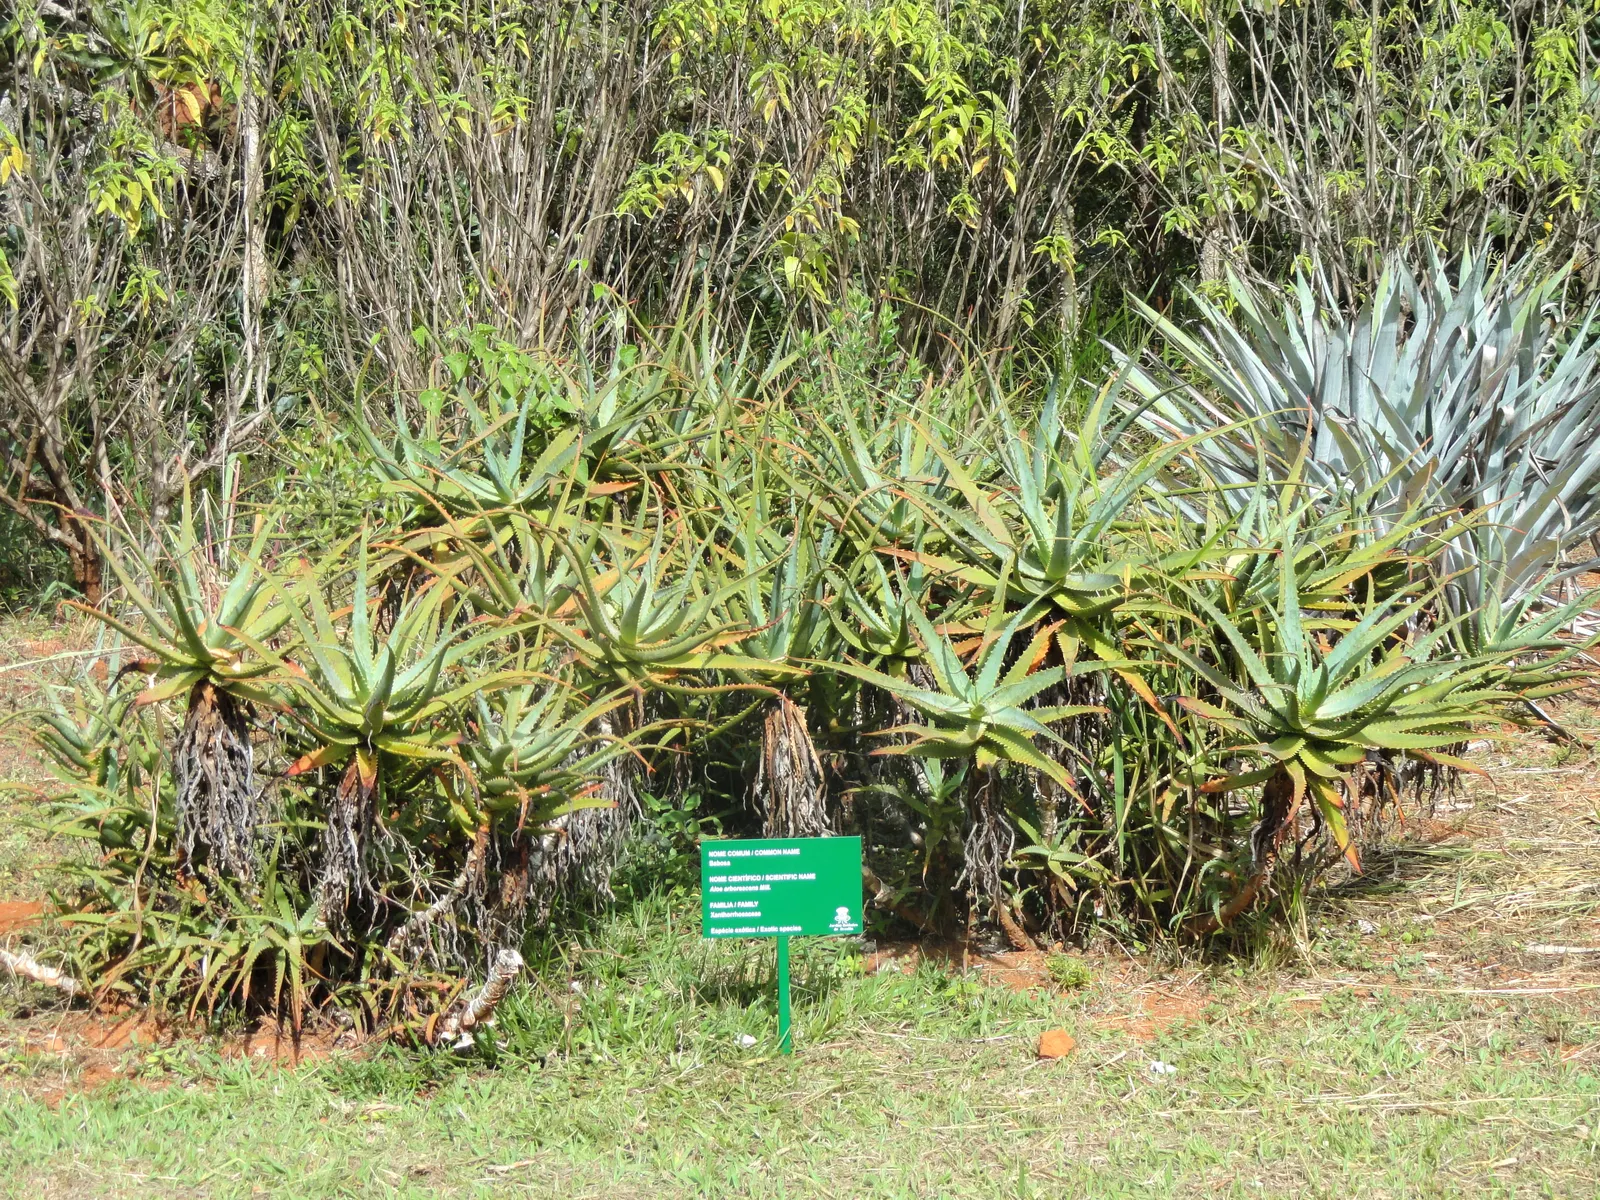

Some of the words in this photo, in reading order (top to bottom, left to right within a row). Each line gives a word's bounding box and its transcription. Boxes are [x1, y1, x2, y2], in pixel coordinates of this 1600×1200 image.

[728, 874, 761, 882] CIENTÍFICO
[711, 927, 734, 935] Espécie
[779, 925, 802, 933] species
